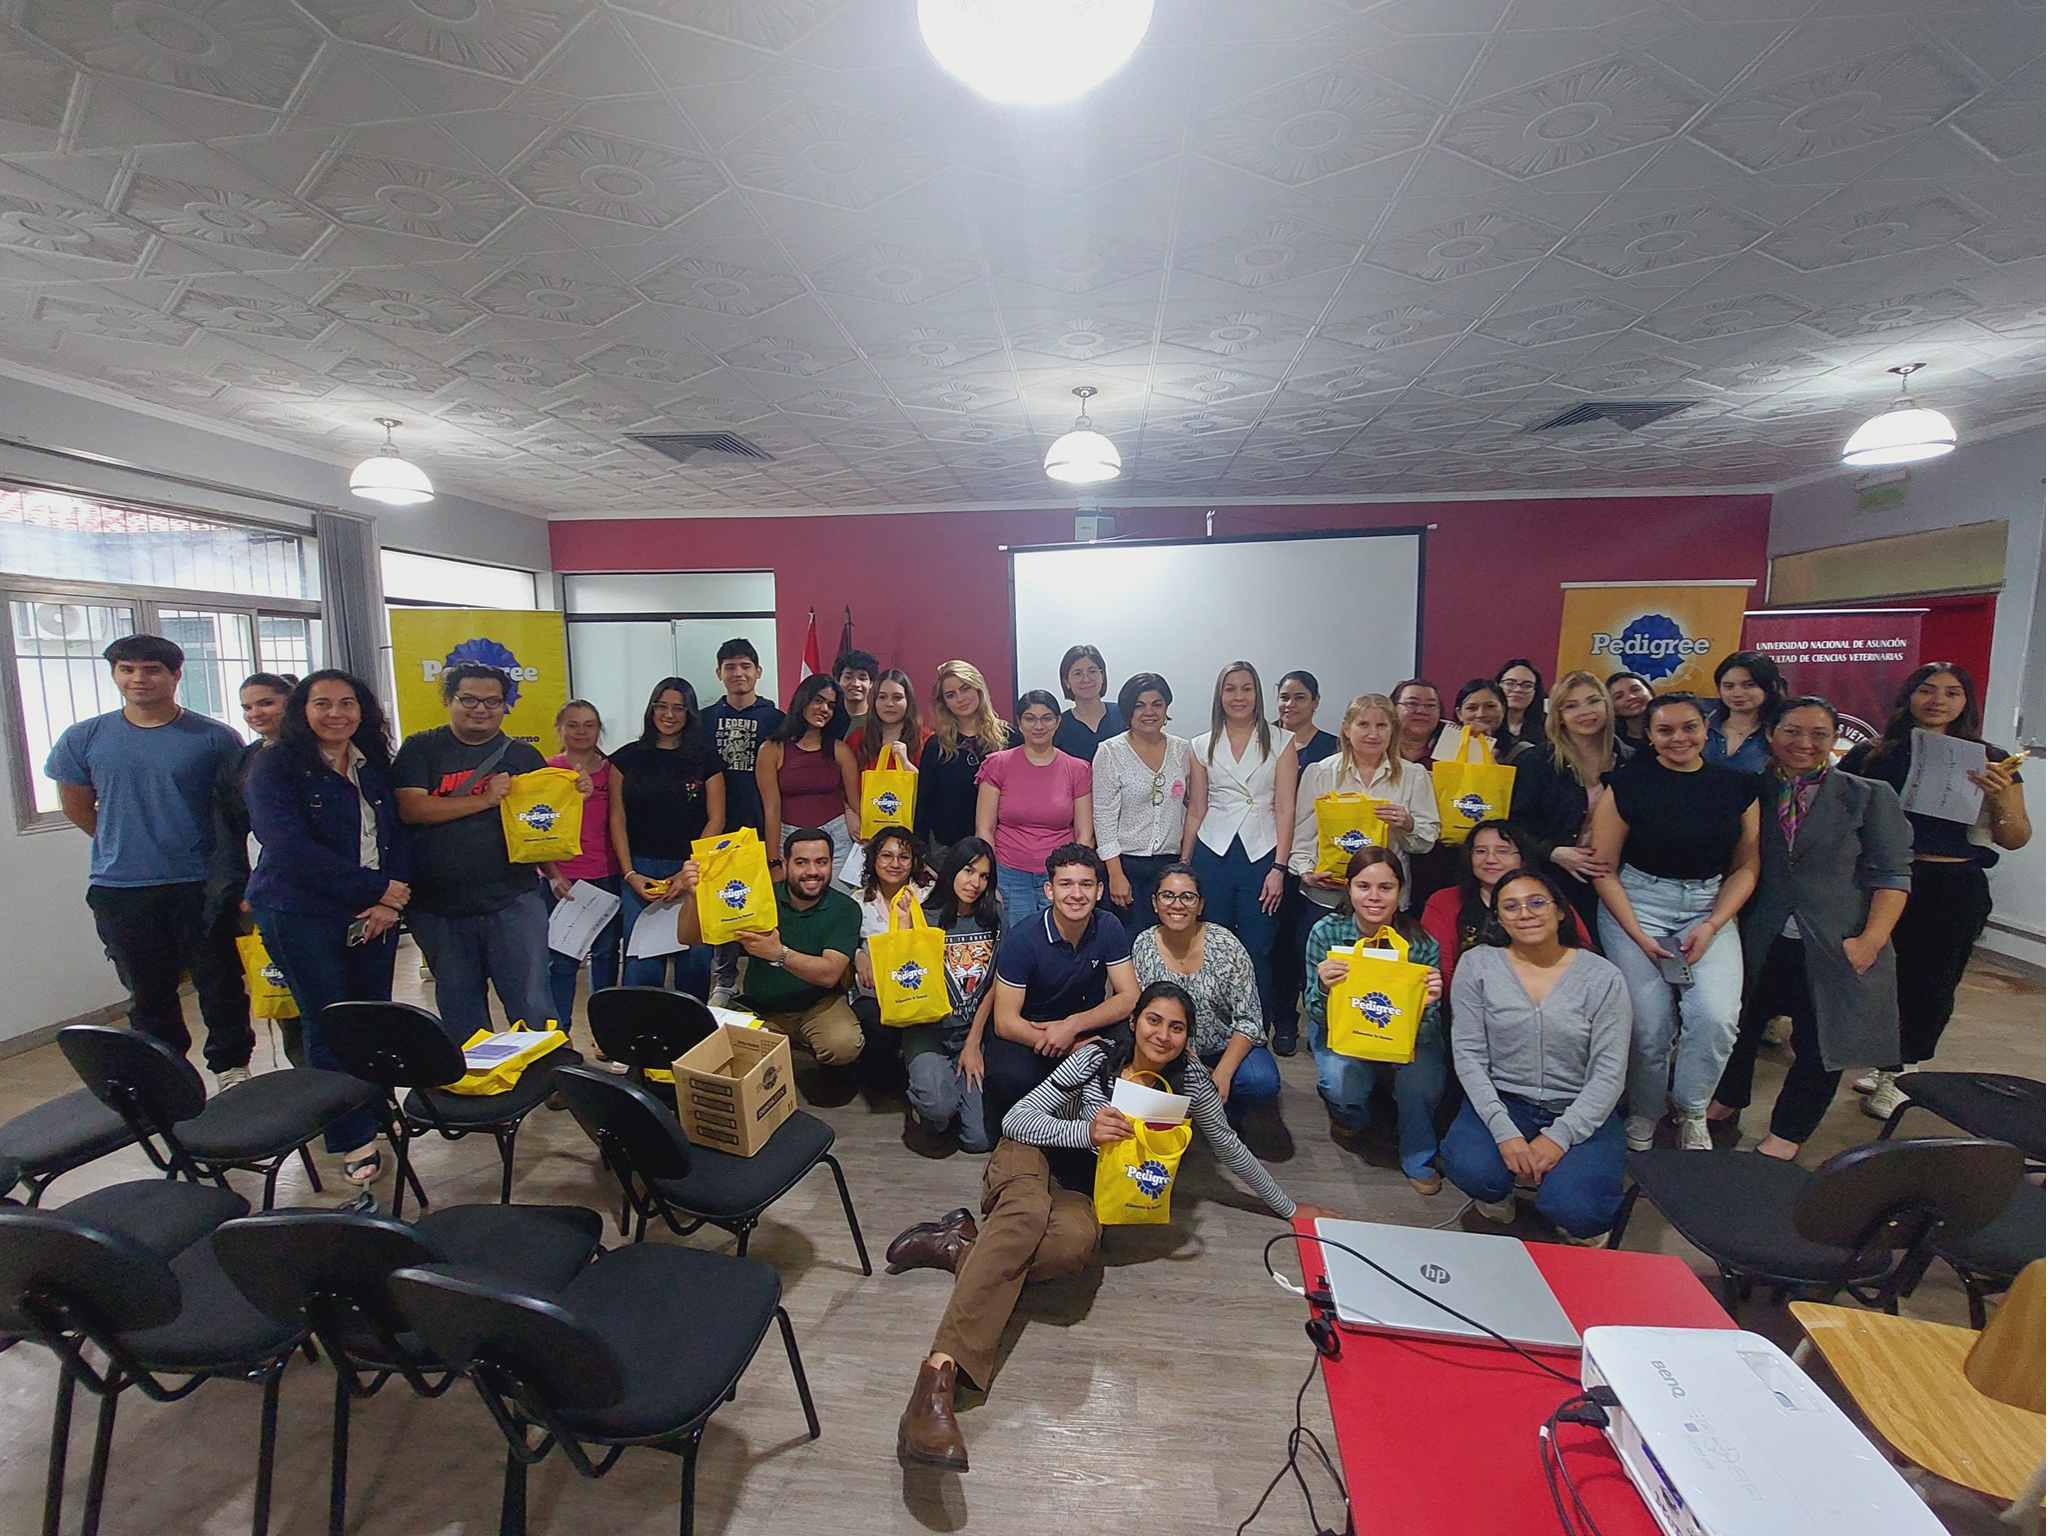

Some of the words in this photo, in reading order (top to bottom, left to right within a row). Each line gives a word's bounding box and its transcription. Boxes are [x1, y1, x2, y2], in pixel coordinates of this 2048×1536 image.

[1590, 633, 1711, 659] Pedigree
[1756, 641, 1808, 650] UNIVERSIDAD
[1810, 640, 1850, 649] NACIONAL
[1852, 640, 1864, 648] DE
[1865, 637, 1907, 648] ASUNCIÓN
[1812, 654, 1847, 662] CIENCIAS
[1849, 653, 1903, 662] VETERINARIAS
[718, 718, 758, 731] LEGEND
[518, 811, 561, 822] Pedigree
[1333, 836, 1374, 848] Pedigree
[718, 886, 752, 900] Pedigree
[891, 967, 929, 981] Pedigree
[1350, 997, 1403, 1016] Pedigree
[1425, 1263, 1447, 1284] hp
[1651, 1360, 1686, 1399] BenQ
